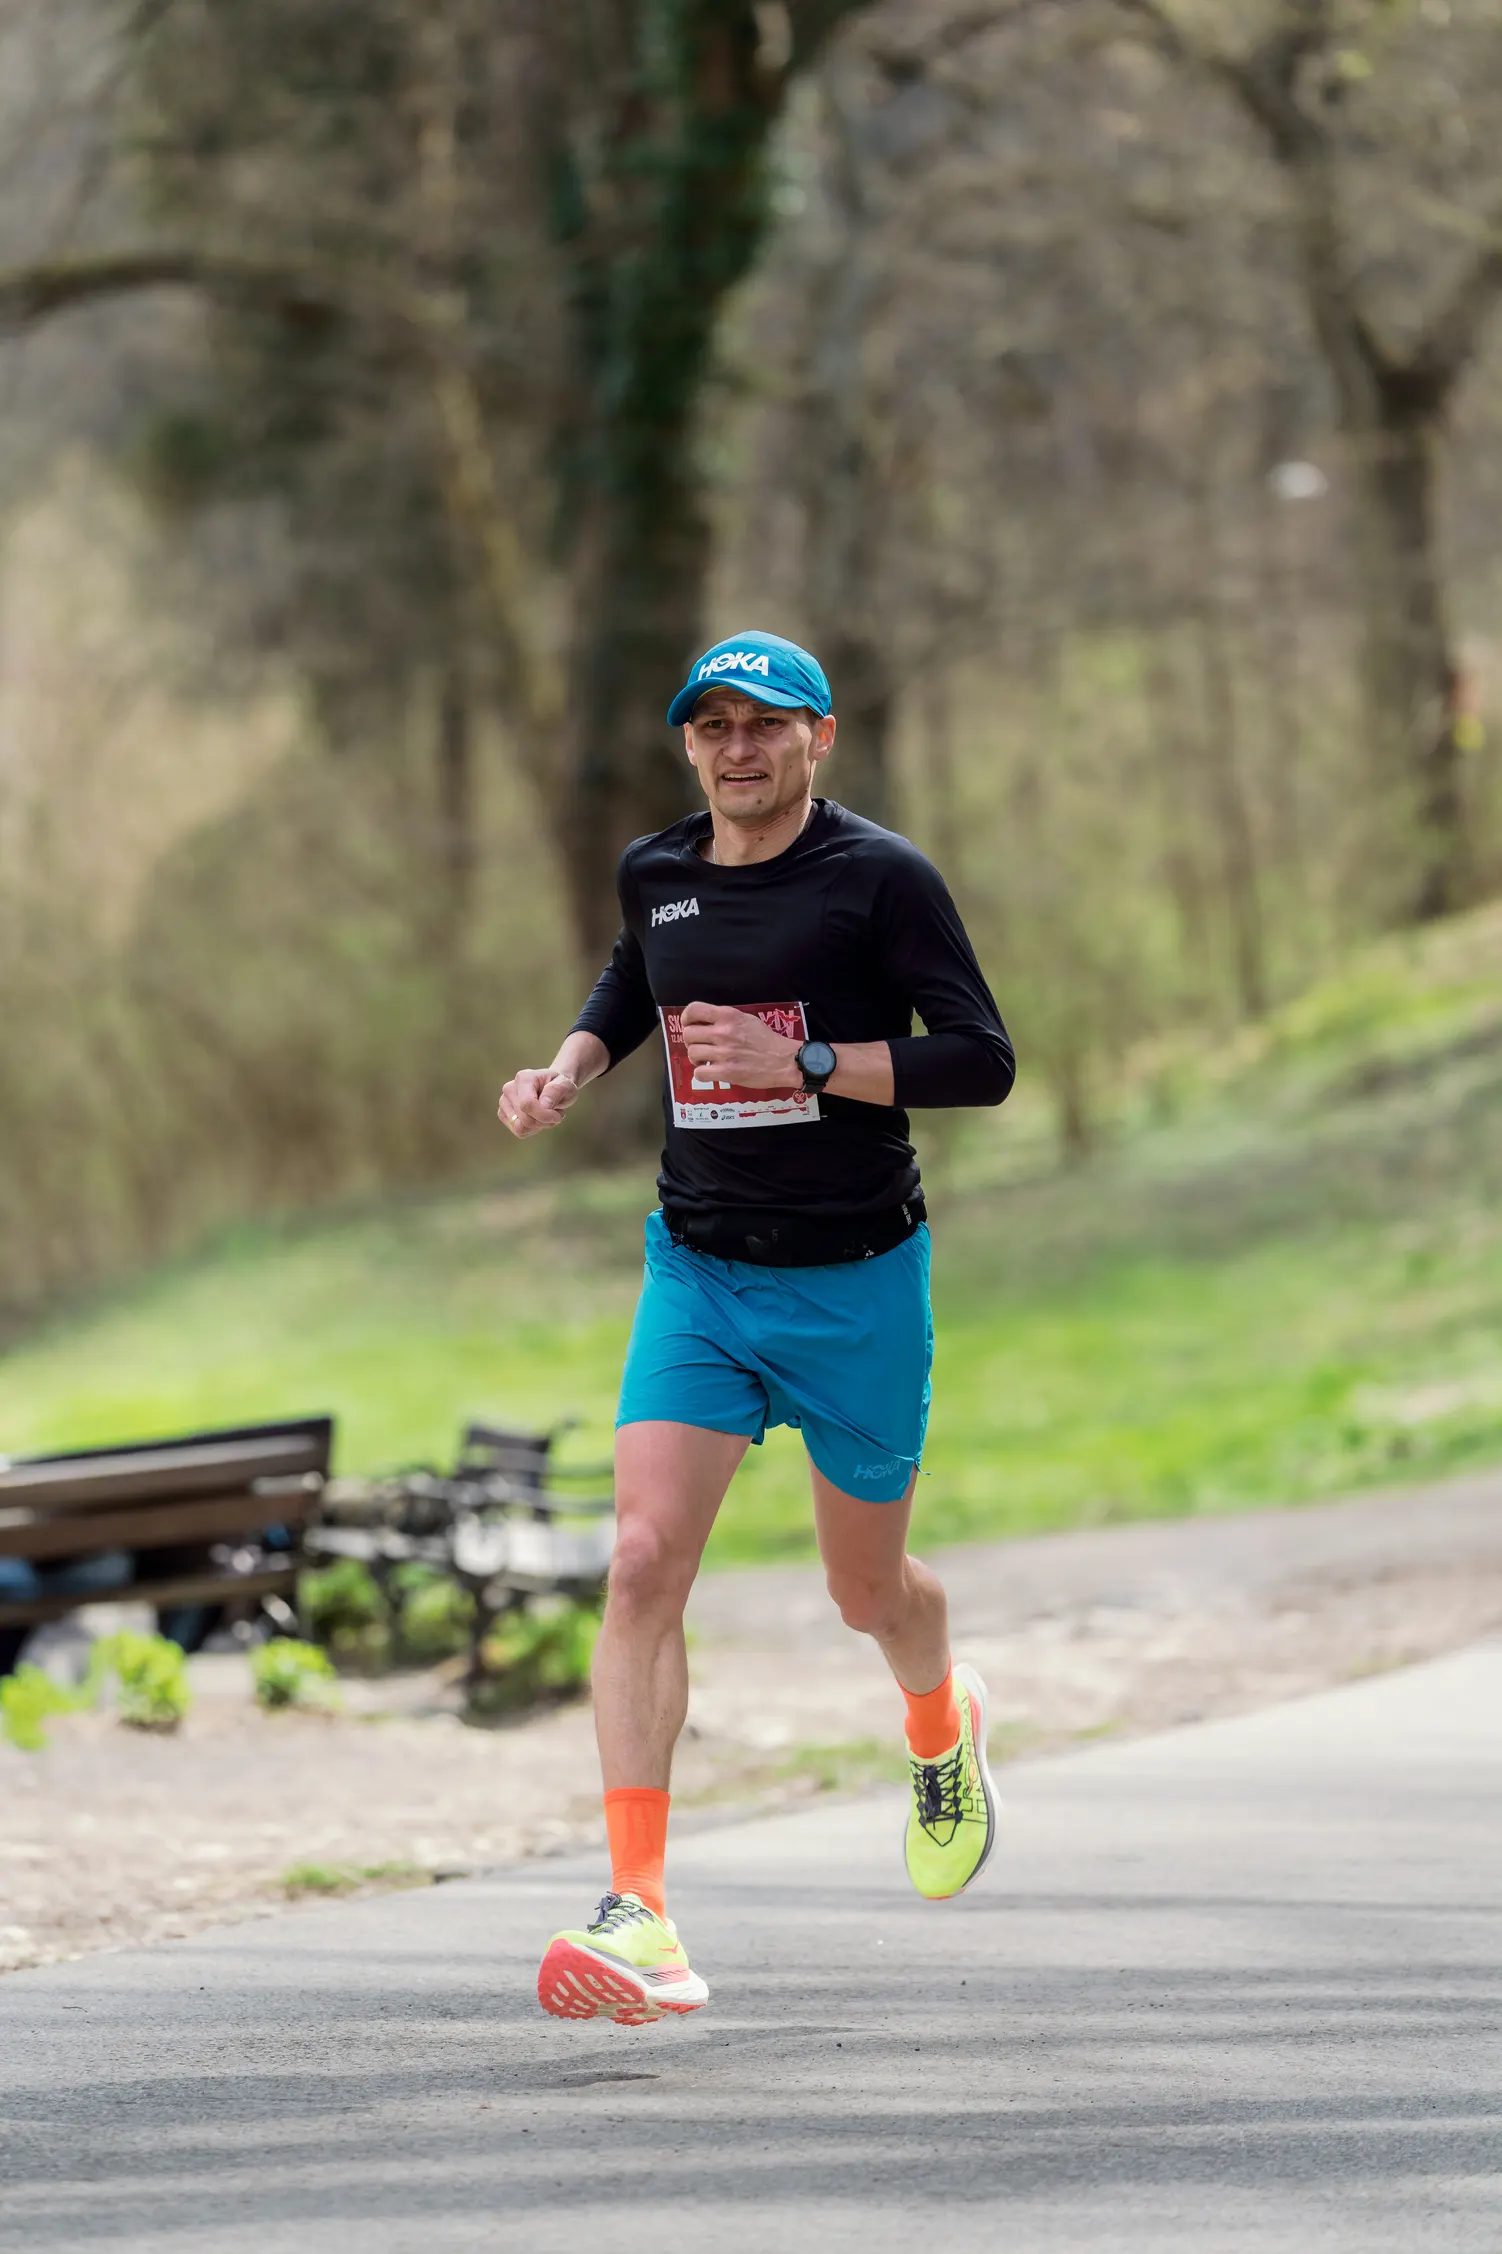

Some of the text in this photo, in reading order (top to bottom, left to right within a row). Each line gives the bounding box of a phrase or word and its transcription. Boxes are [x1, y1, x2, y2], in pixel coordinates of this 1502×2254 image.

[697, 652, 769, 680] HOKA
[651, 898, 700, 928] HOKA
[668, 1015, 684, 1033] SK
